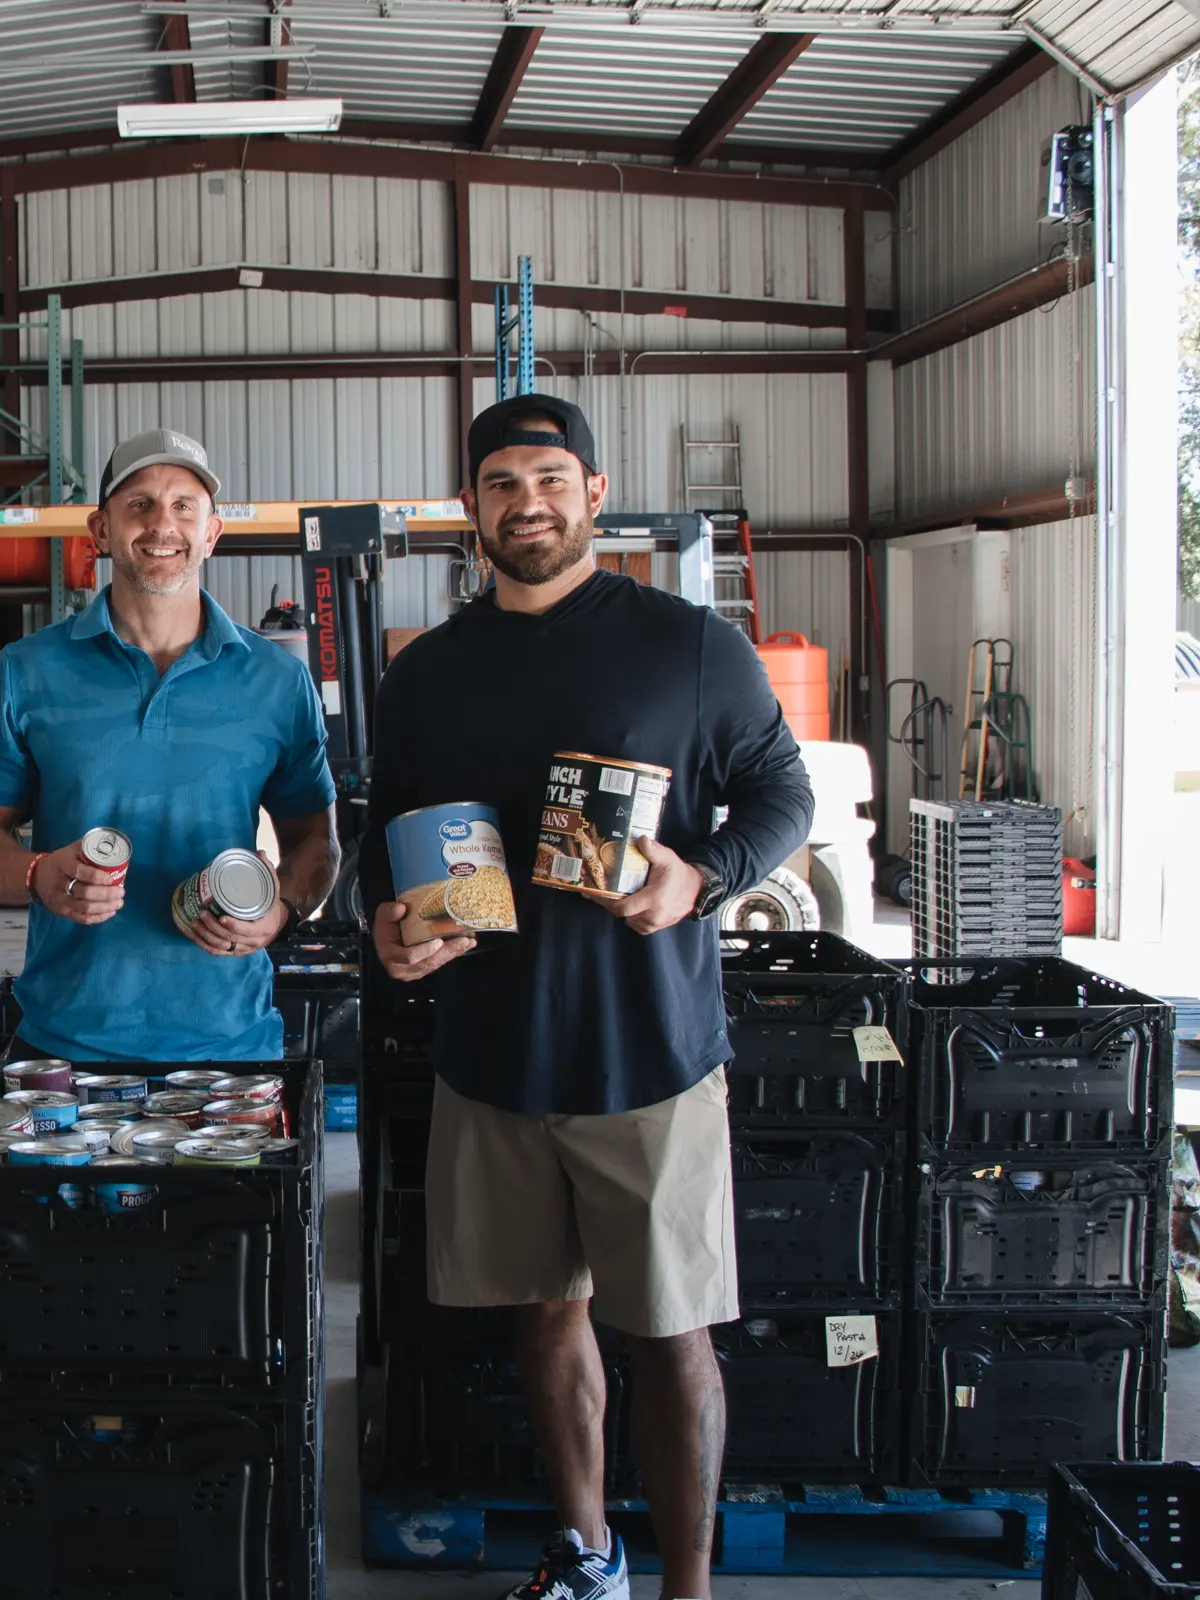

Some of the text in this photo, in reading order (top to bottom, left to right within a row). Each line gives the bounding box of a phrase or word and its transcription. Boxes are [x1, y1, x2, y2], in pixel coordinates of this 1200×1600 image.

[315, 567, 337, 681] KOMATSU
[443, 823, 467, 834] Great
[449, 829, 469, 838] Value
[449, 845, 480, 855] Whole
[828, 1321, 847, 1334] DRY
[835, 1332, 866, 1343] PASTA
